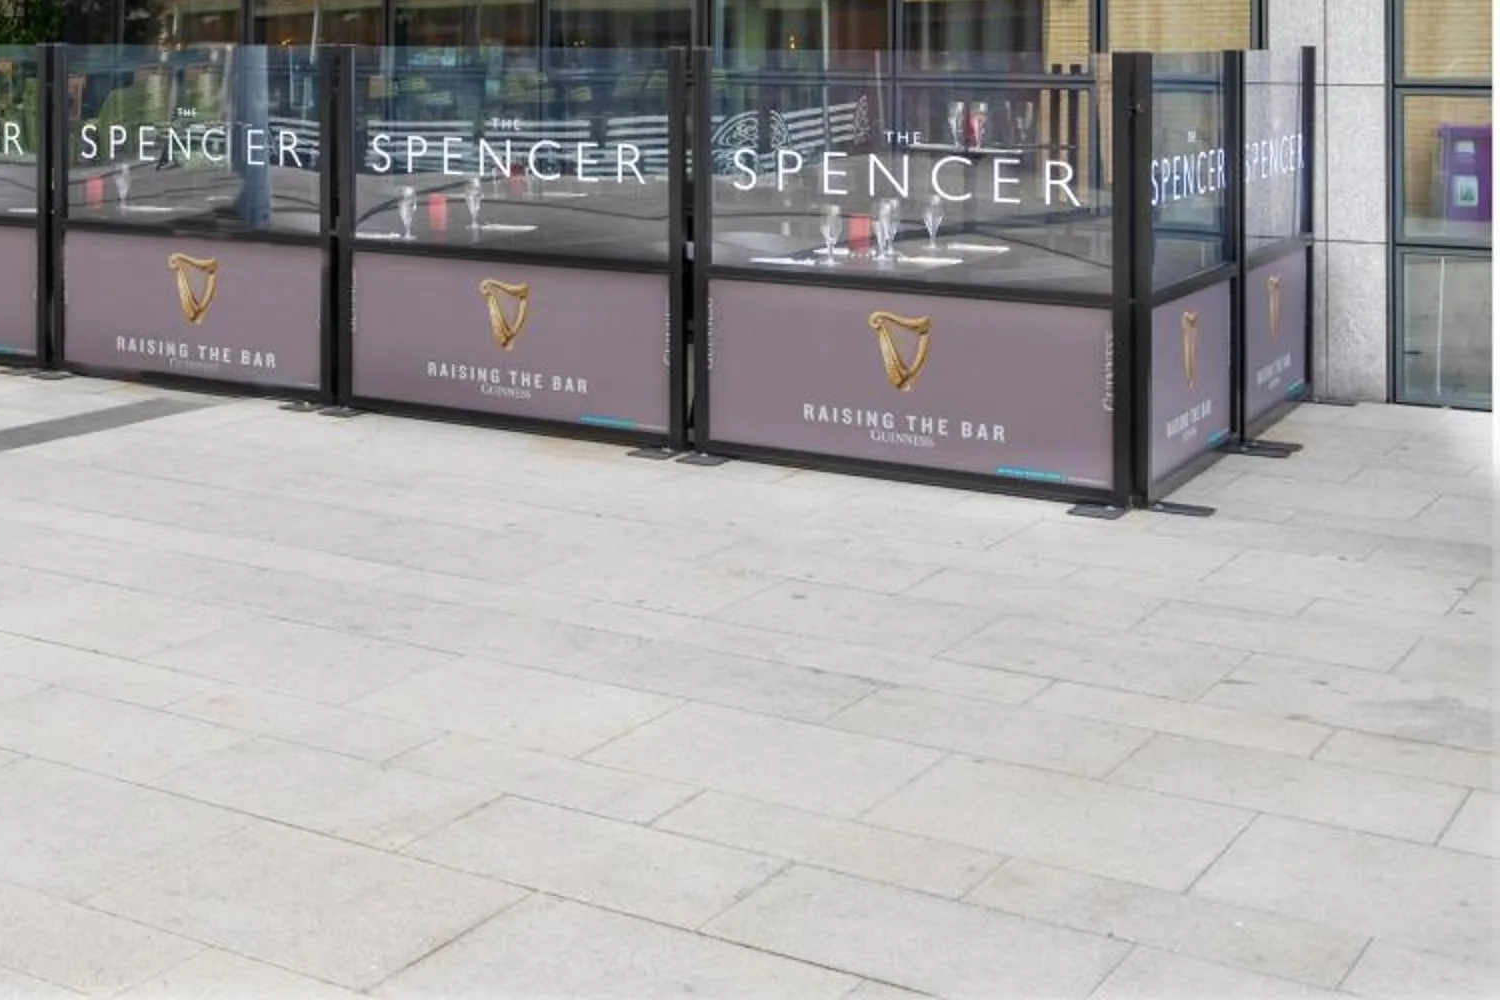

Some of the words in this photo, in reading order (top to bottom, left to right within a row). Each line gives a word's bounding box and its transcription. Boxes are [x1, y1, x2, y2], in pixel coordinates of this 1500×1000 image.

[177, 107, 197, 118] THE
[492, 117, 521, 131] THE
[81, 124, 302, 167] SPENCER
[884, 131, 921, 145] THE
[372, 134, 646, 185] SPENCER
[1151, 147, 1226, 207] SPENCER
[1244, 133, 1305, 184] SPENCER
[732, 149, 1081, 207] SPENCER
[115, 335, 190, 359] RAISING
[199, 344, 231, 364] THE
[241, 349, 277, 369] BAR
[426, 360, 500, 384] RAISING
[509, 370, 543, 390] THE
[552, 375, 588, 394] BAR
[802, 403, 896, 430] RAISING
[905, 414, 949, 436] THE
[961, 420, 1006, 443] BAR
[869, 429, 936, 448] GUINNESS
